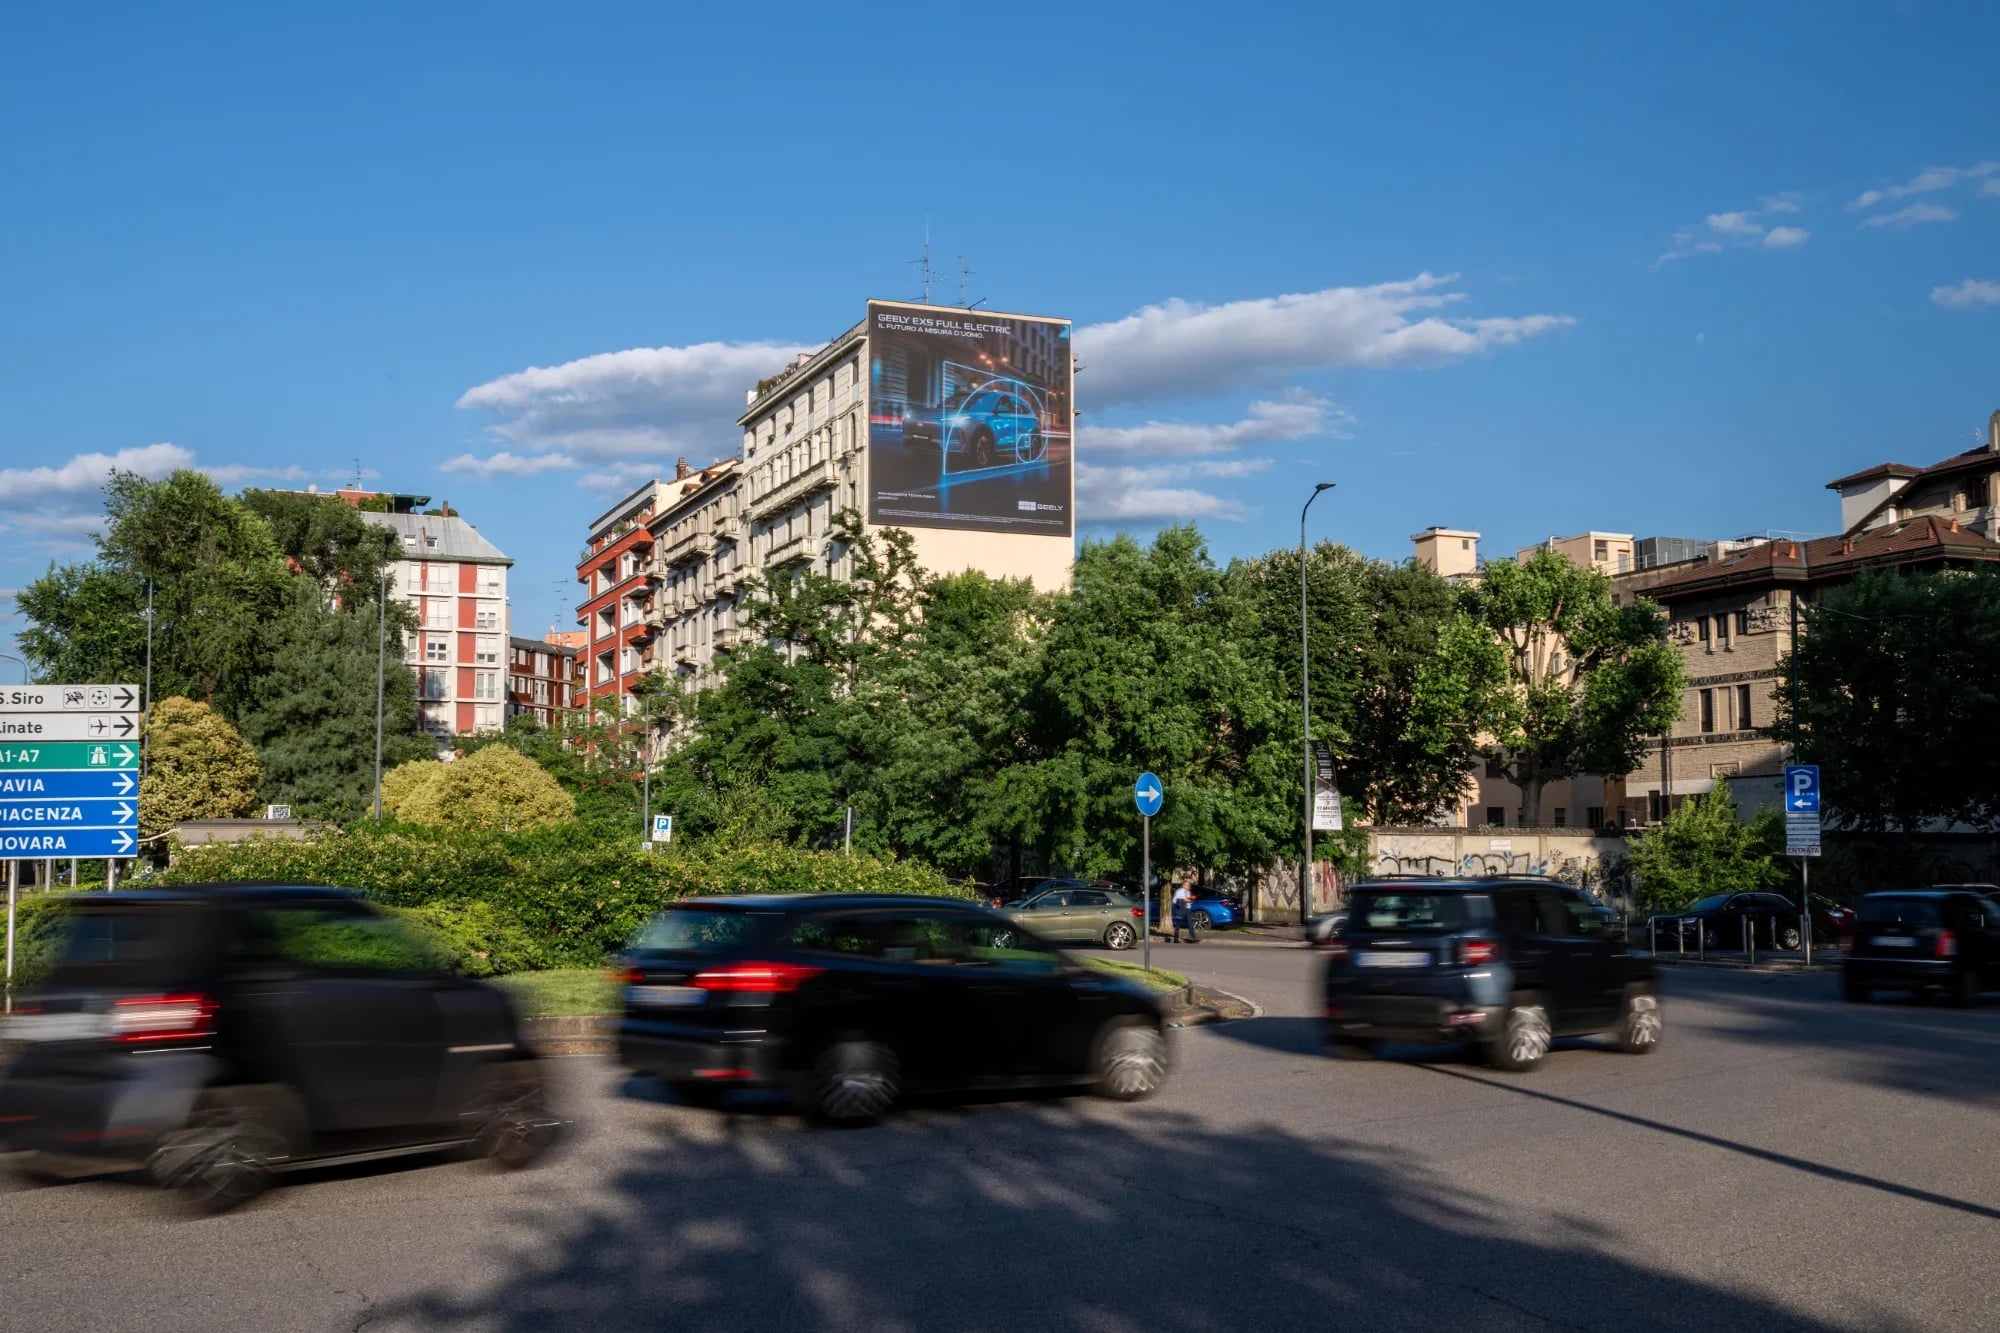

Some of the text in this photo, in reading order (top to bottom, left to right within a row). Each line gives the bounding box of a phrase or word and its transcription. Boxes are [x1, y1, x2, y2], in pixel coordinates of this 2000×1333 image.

[878, 314, 910, 324] GEELY
[936, 319, 962, 330] FULL
[963, 322, 1011, 335] ELECTRIC
[886, 323, 917, 332] FUTURO
[925, 327, 953, 336] MISURA
[0, 721, 43, 734] inate
[0, 778, 45, 792] AVIA
[1794, 775, 1812, 796] P
[0, 806, 83, 821] IACENZA
[659, 819, 667, 828] P
[0, 835, 67, 850] OVARA
